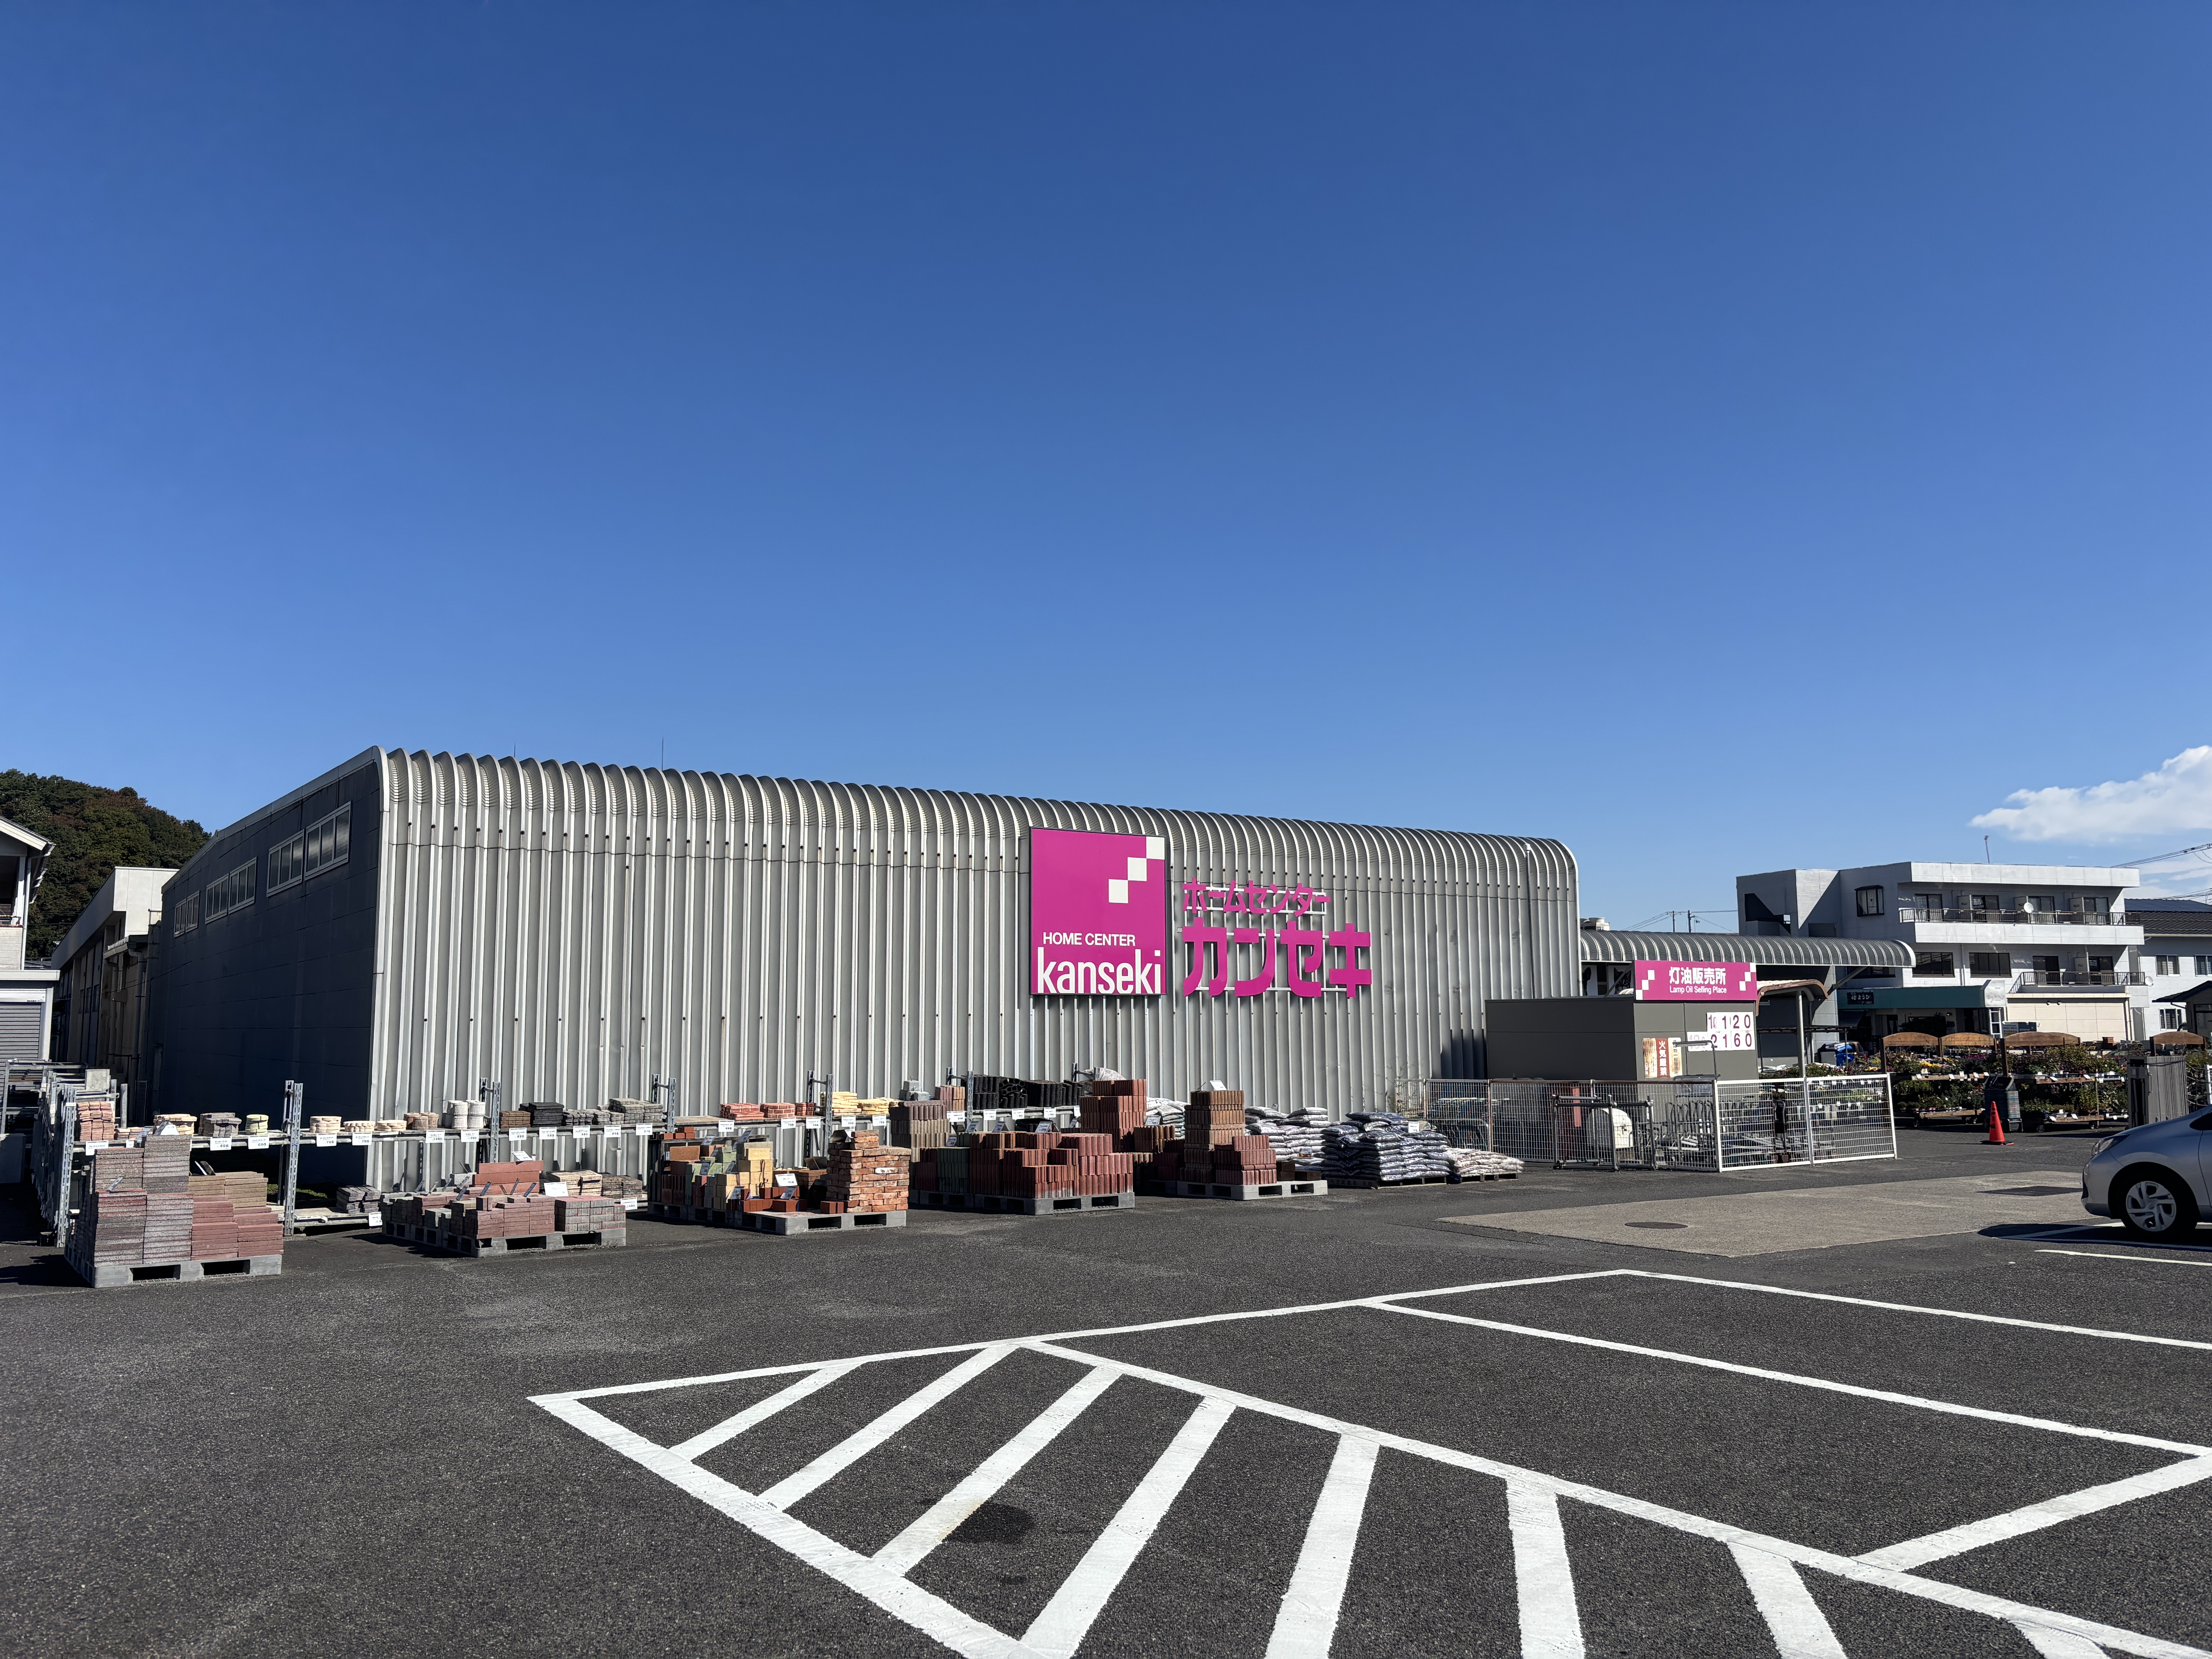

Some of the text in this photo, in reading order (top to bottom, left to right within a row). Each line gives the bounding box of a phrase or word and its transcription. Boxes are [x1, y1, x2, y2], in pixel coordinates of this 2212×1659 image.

[1182, 877, 1331, 917] ホームセンター
[1043, 932, 1135, 946] HOME CENTER
[1037, 946, 1161, 994] kanseki
[1182, 917, 1372, 998] カンセキ
[1669, 967, 1726, 985] 灯油販売所
[1669, 986, 1684, 994] Lamp
[1694, 986, 1711, 994] Selling
